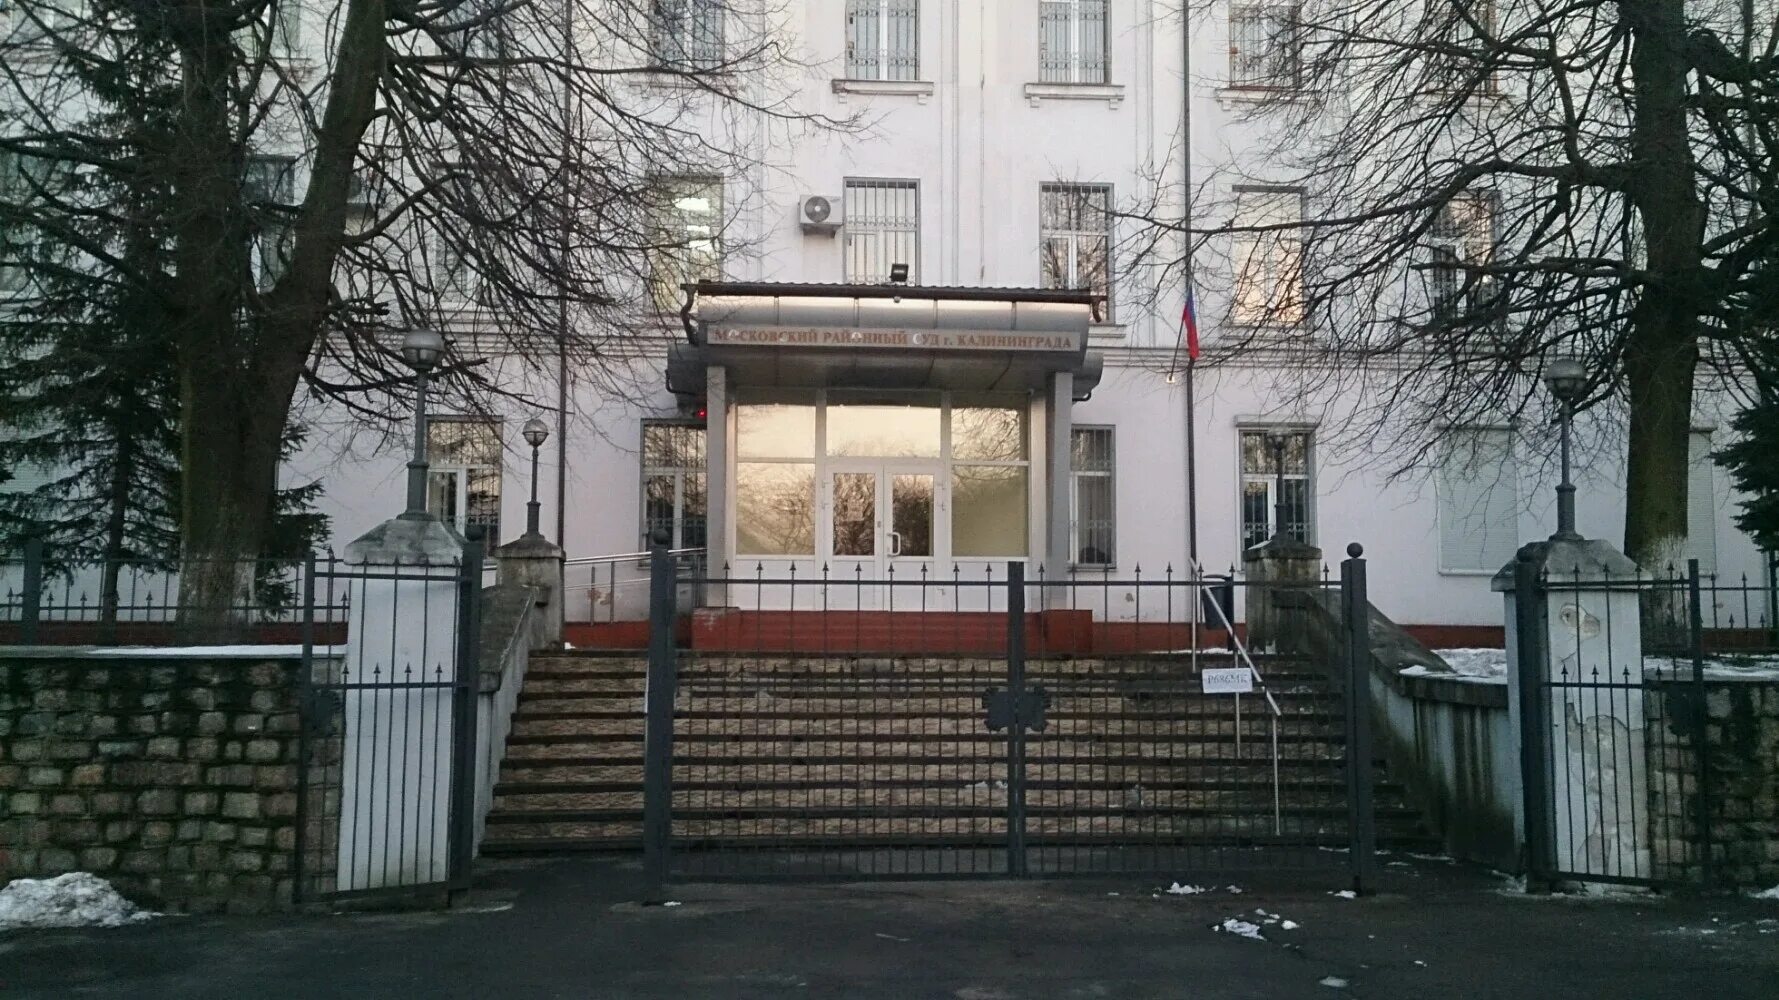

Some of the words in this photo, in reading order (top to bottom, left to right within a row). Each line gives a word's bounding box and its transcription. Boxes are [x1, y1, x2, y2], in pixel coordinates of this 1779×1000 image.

[823, 328, 908, 345] РАЙОННЫЙ
[912, 332, 940, 346] СУД
[957, 334, 1073, 349] КАЛИНИНГРАДА
